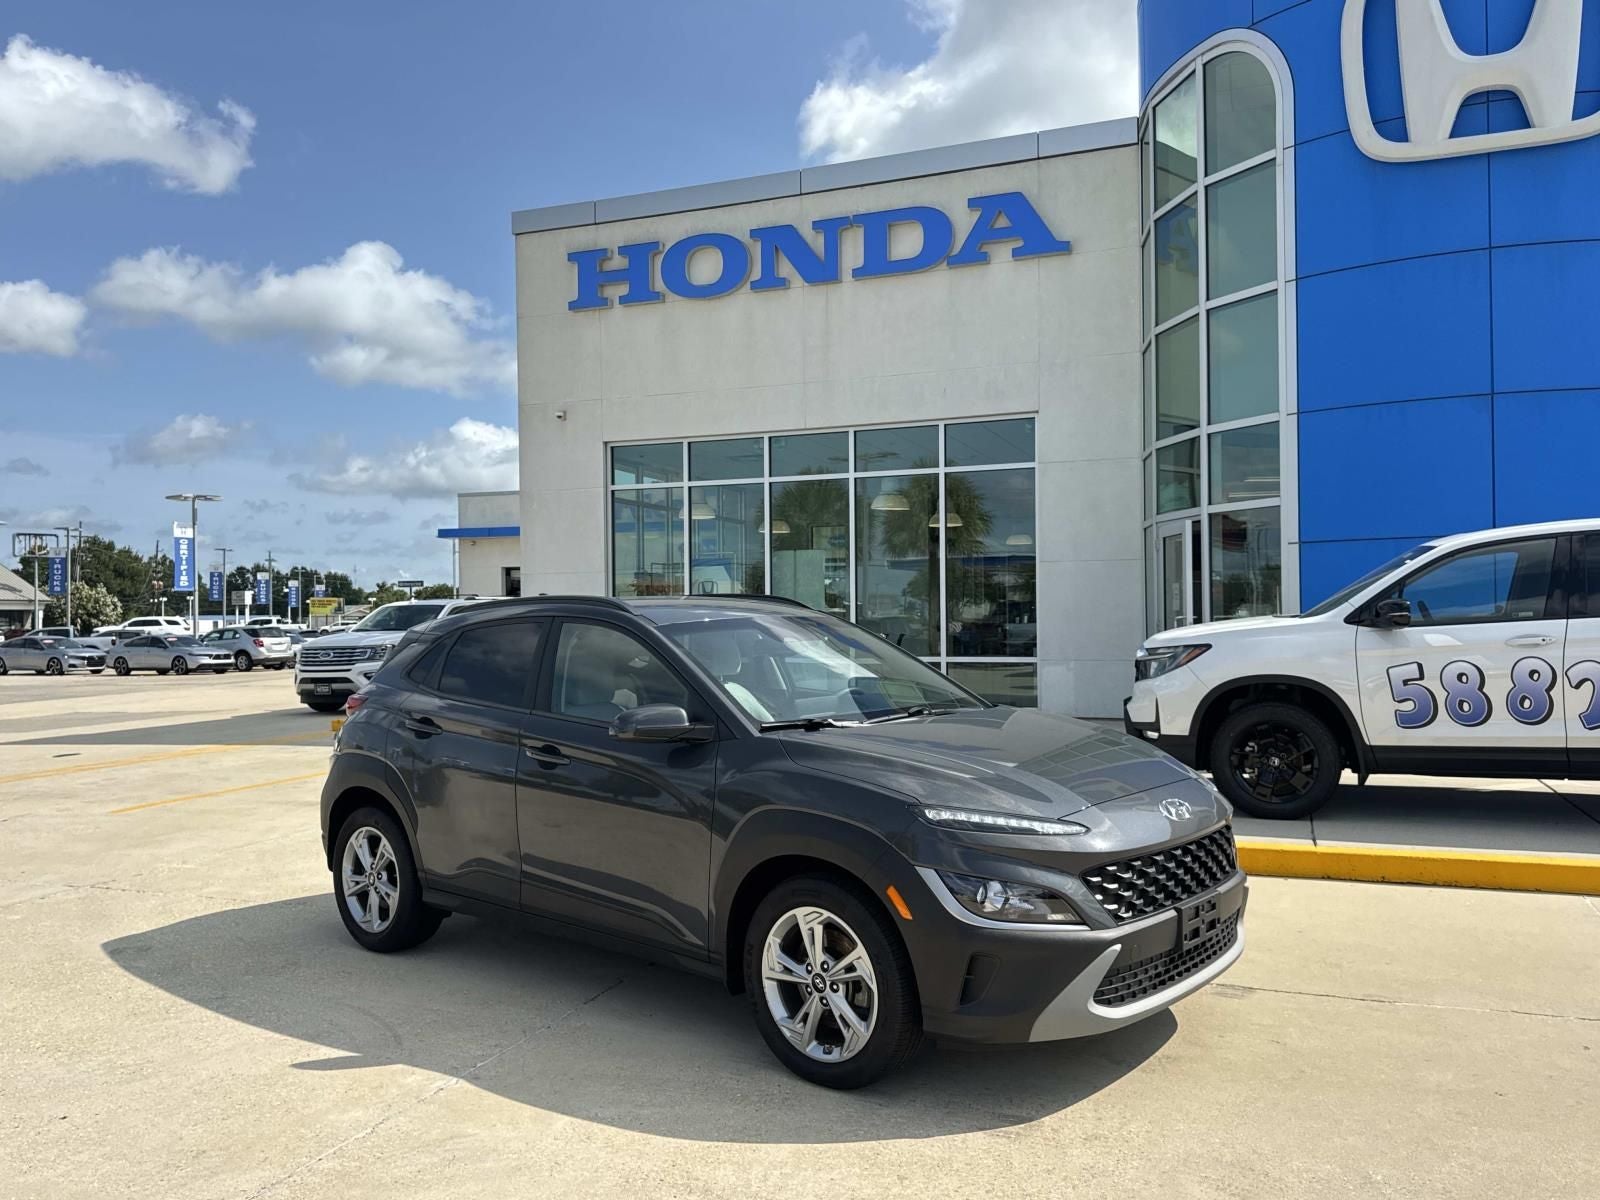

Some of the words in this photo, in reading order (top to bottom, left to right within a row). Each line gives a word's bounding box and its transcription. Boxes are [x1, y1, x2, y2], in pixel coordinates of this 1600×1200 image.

[567, 191, 1072, 311] HONDA
[53, 558, 61, 592] TRUCKS
[179, 539, 189, 587] CERTIFIED
[1386, 656, 1600, 730] 5882
